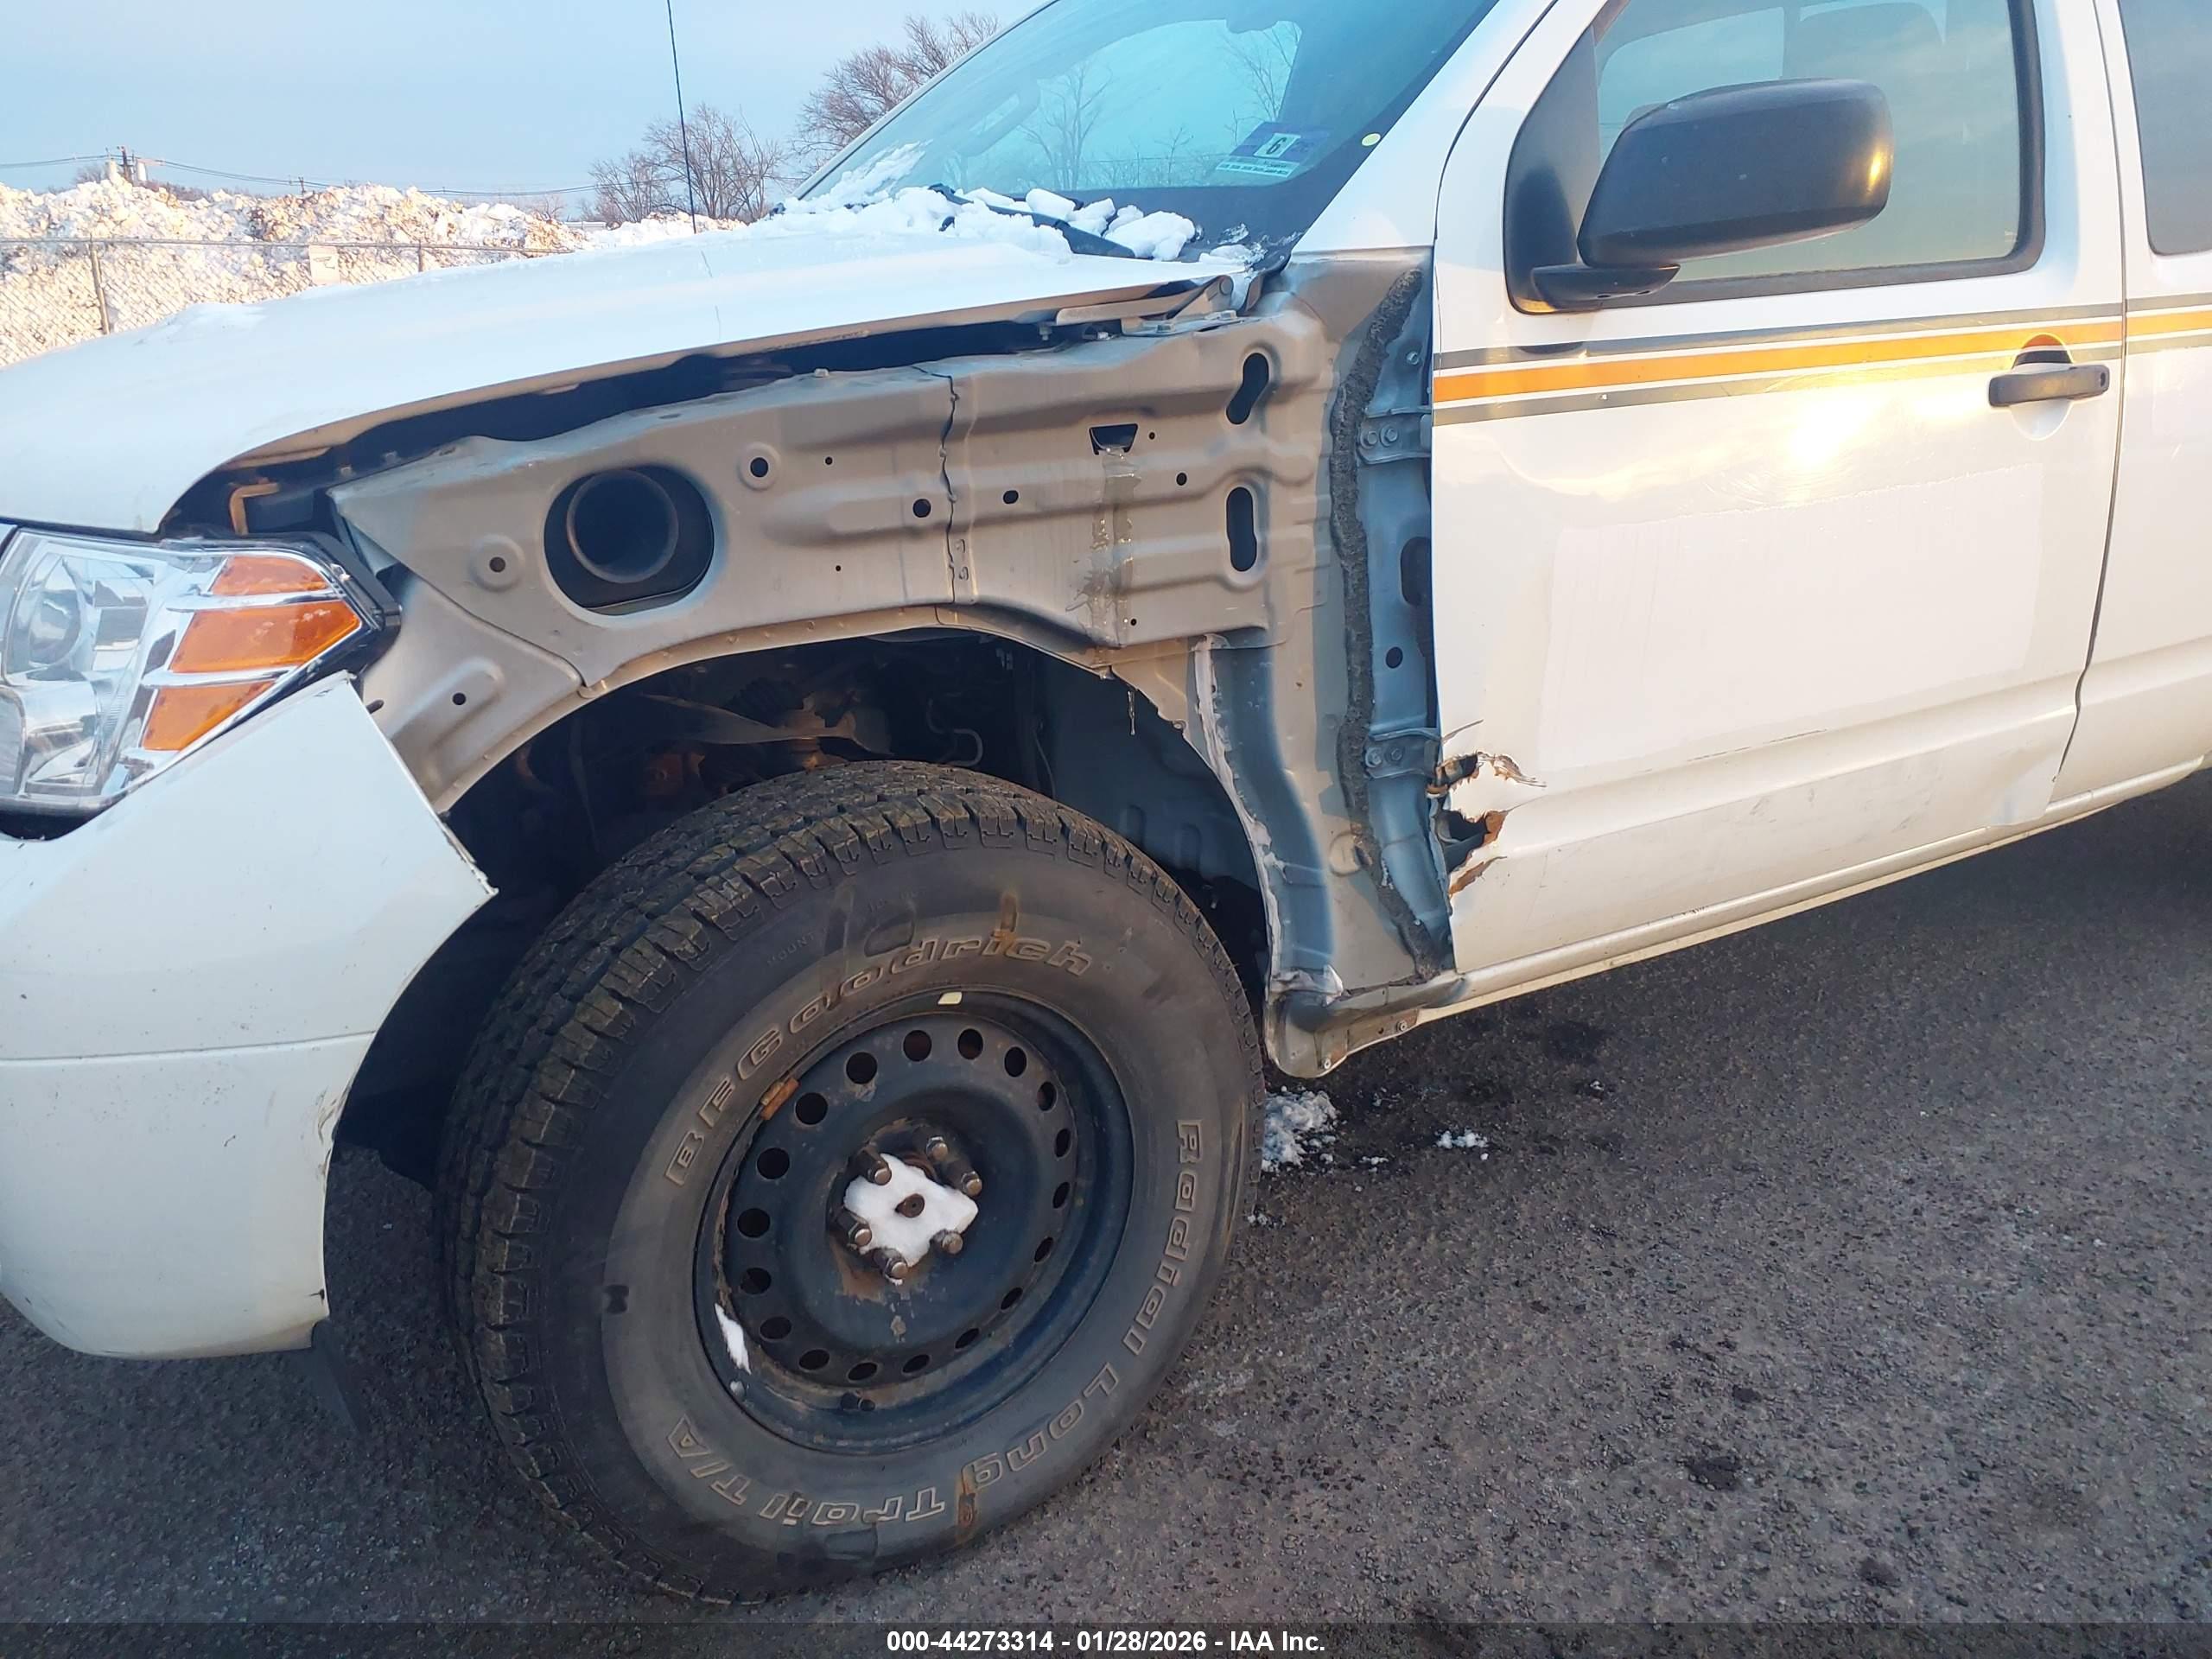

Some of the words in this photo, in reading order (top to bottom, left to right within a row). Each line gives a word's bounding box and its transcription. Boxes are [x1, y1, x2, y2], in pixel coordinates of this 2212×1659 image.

[664, 931, 1092, 1187] BFGoodrich
[1123, 1120, 1202, 1355] Radial
[666, 1414, 752, 1505] T/A
[962, 1363, 1119, 1491] Long
[759, 1486, 945, 1526] Trail
